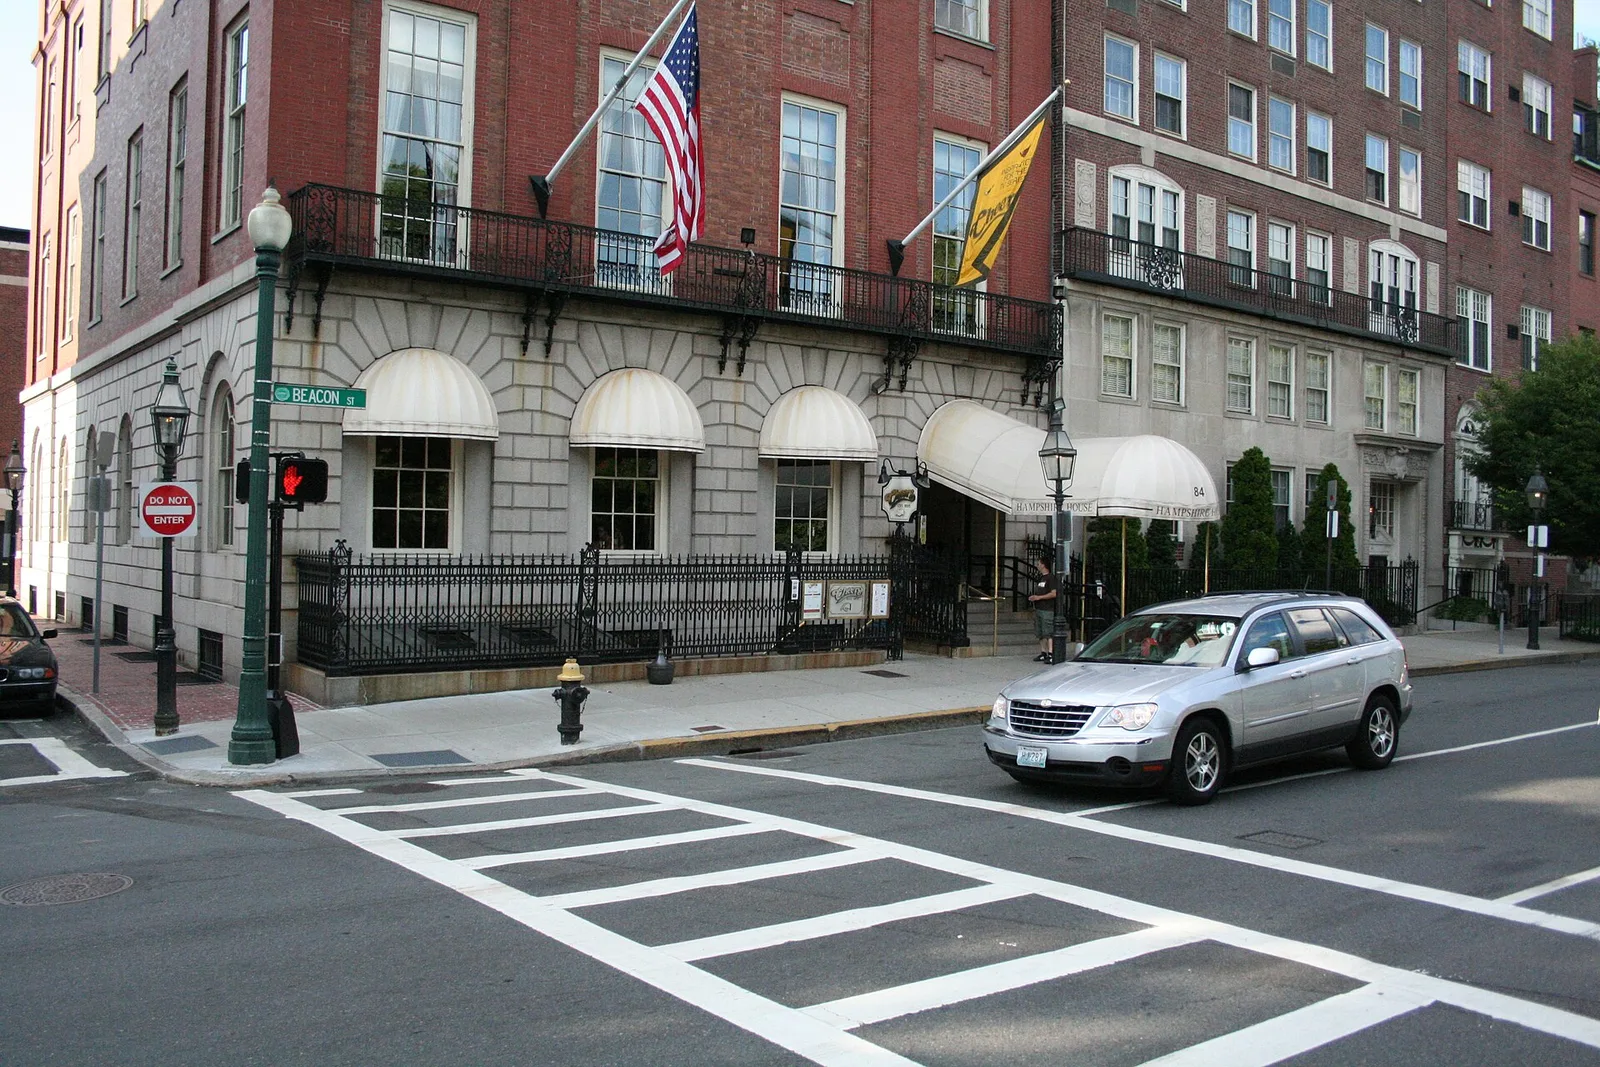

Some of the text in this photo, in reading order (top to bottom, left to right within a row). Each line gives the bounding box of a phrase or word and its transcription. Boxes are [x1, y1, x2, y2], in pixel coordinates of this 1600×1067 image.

[970, 194, 1014, 238] Cheer
[292, 387, 340, 405] BEACON
[346, 396, 355, 406] ST
[1193, 486, 1205, 497] 84
[150, 496, 188, 505] DO NOT
[1016, 502, 1093, 512] HAMPSHIR HOUSE
[154, 516, 185, 525] ENTER
